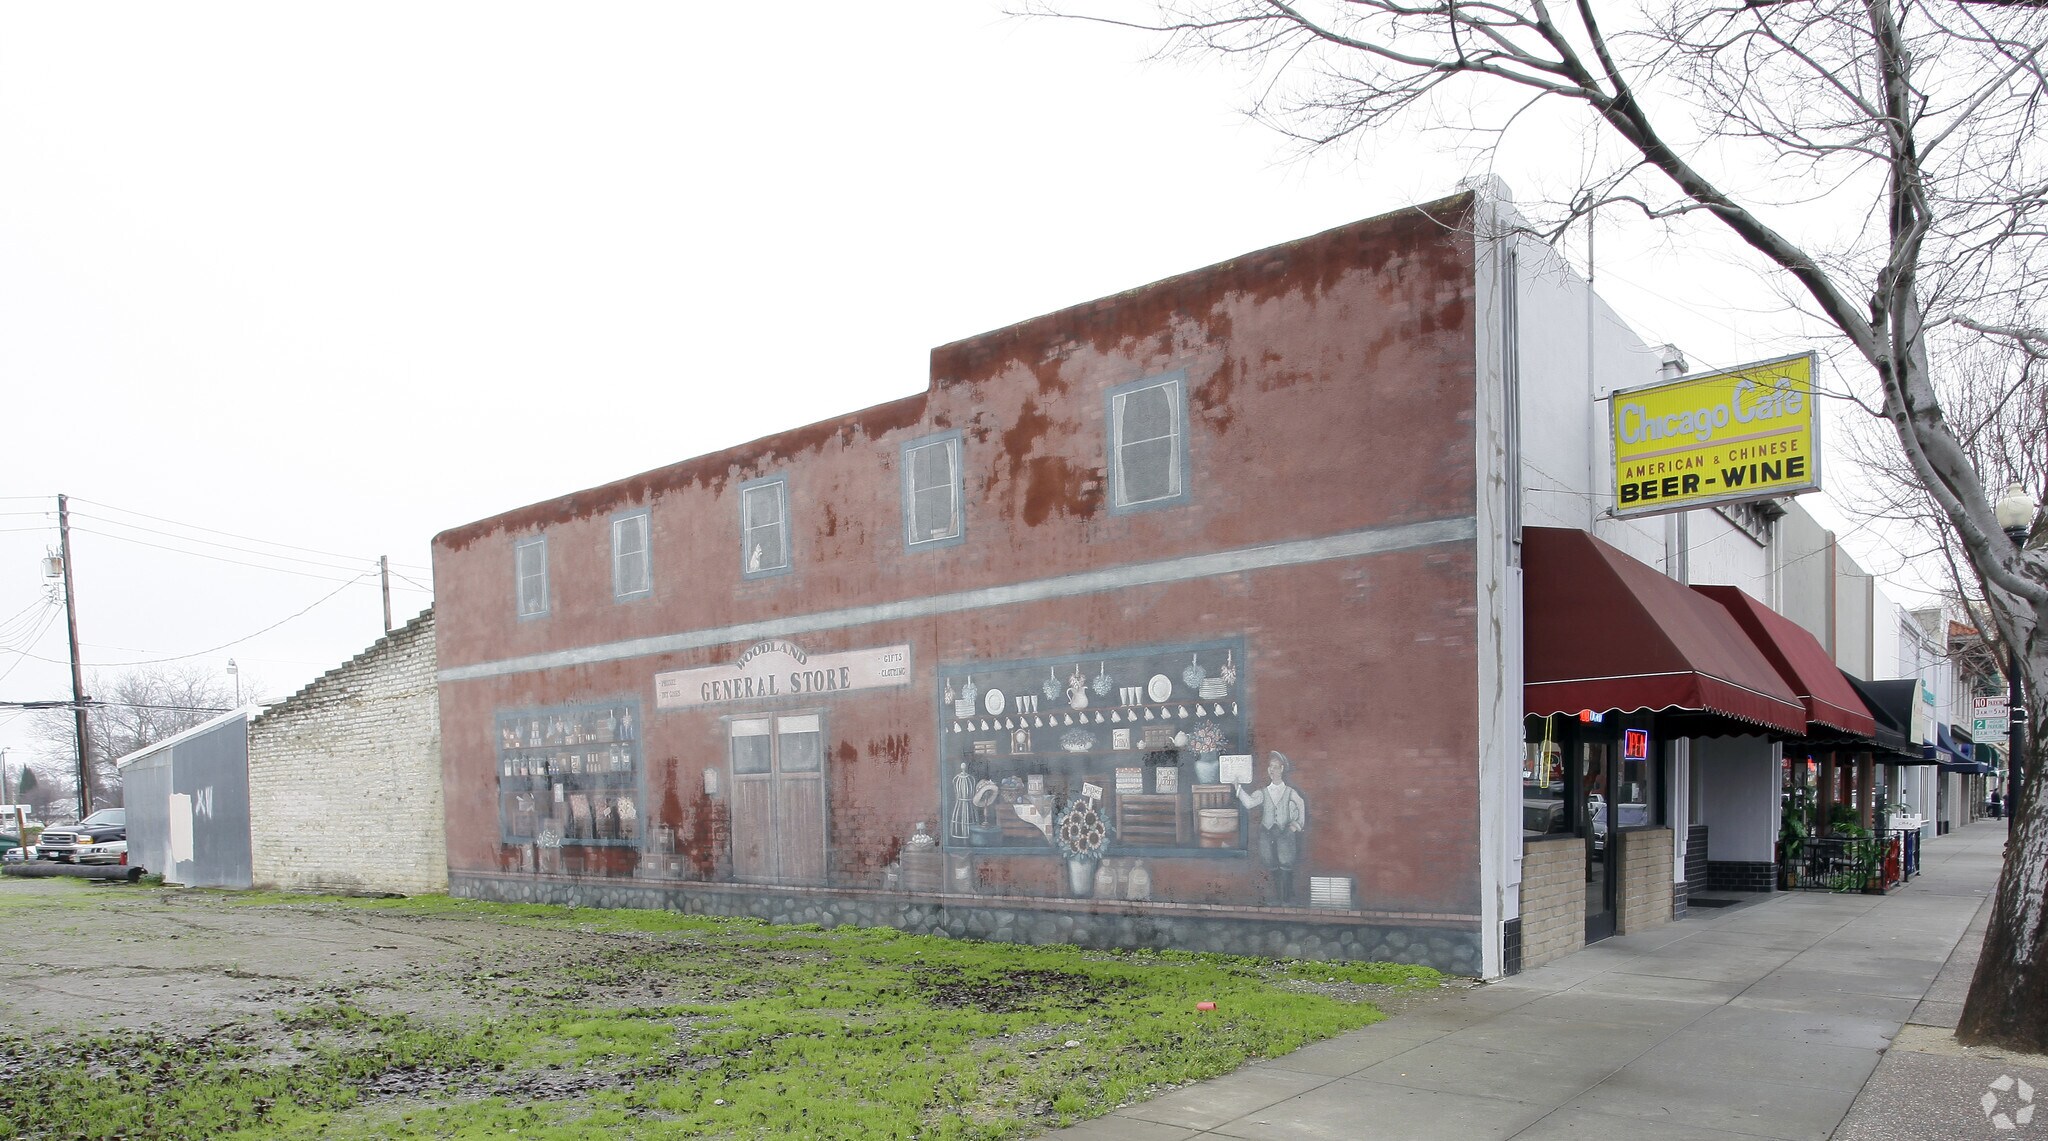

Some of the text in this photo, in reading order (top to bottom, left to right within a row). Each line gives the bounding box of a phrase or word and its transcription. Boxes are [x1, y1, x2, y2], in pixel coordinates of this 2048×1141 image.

[1618, 403, 1729, 444] Chicago
[1626, 439, 1799, 479] AMERICAN & CHINESE
[736, 641, 808, 670] WOODLAND
[883, 653, 903, 663] GIFTS
[701, 666, 851, 702] GENERAL STORE
[1975, 699, 1986, 707] NO
[1976, 720, 1983, 729] 2
[1626, 731, 1646, 758] OPEN
